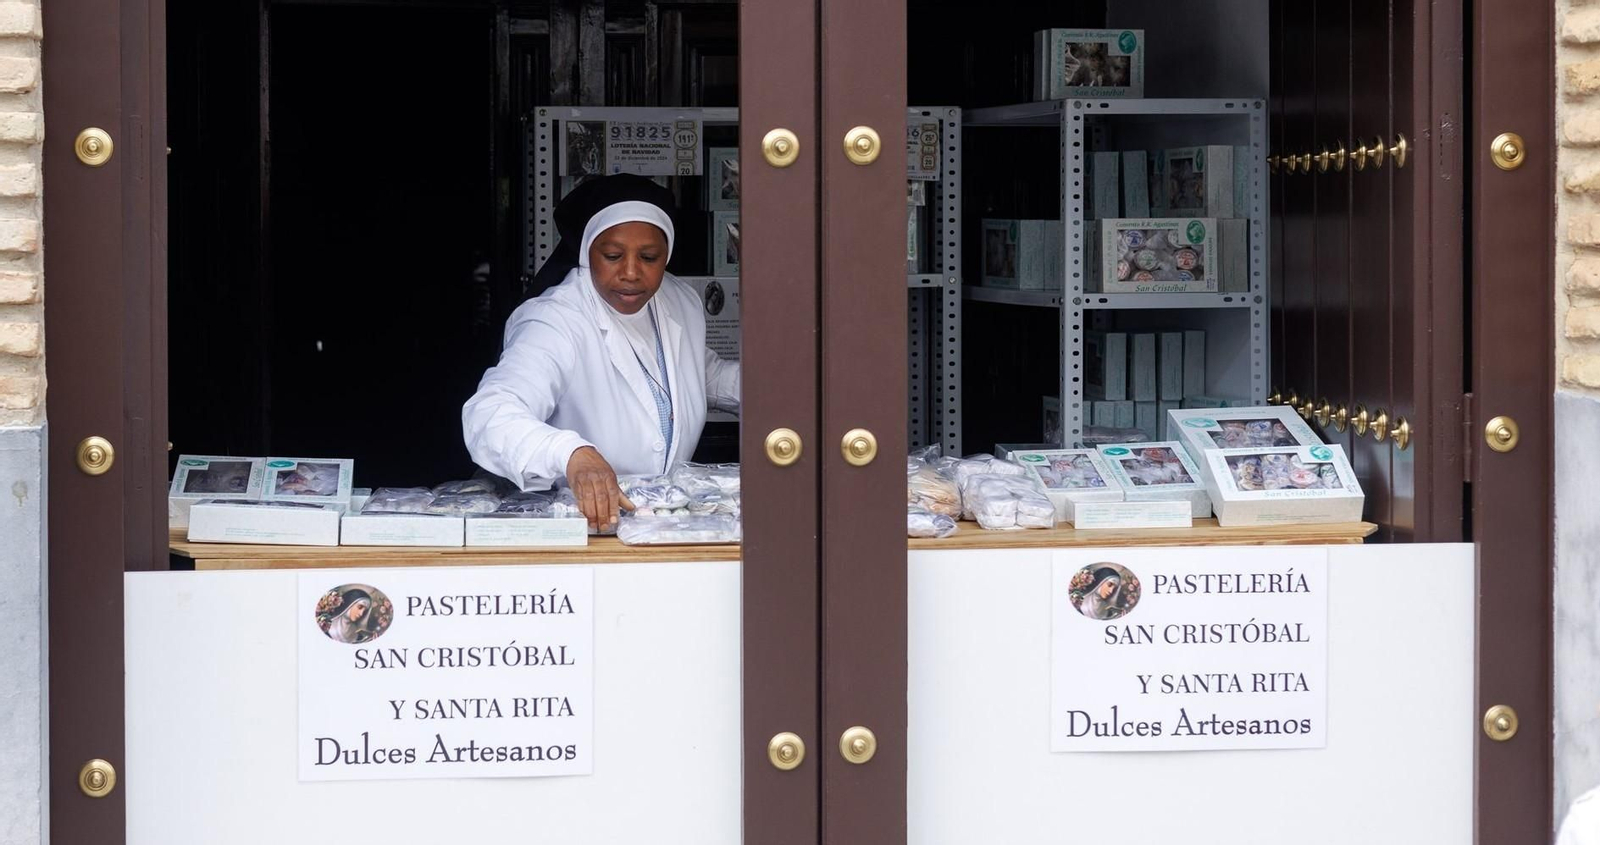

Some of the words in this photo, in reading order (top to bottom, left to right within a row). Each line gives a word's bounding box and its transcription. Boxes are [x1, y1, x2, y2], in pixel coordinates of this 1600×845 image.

[610, 126, 671, 139] 91825
[1152, 284, 1187, 292] Cristóbal
[1264, 489, 1282, 498] San
[1153, 568, 1310, 594] PASTELERÍA
[406, 588, 575, 616] PASTELERÍA
[1104, 624, 1154, 645] SAN
[1163, 618, 1310, 644] CRISTÓBAL
[354, 648, 408, 669] SAN
[417, 640, 575, 668] CRISTÓBAL
[1137, 675, 1152, 694] Y
[1161, 674, 1243, 694] SANTA
[1252, 673, 1310, 692] RITA
[389, 700, 405, 720] Y
[414, 699, 503, 719] SANTA
[512, 697, 575, 717] RITA
[1066, 705, 1162, 737] Dulces
[1171, 707, 1311, 736] Artesanos
[314, 731, 416, 765] Dulces
[425, 733, 576, 764] Artesanos
